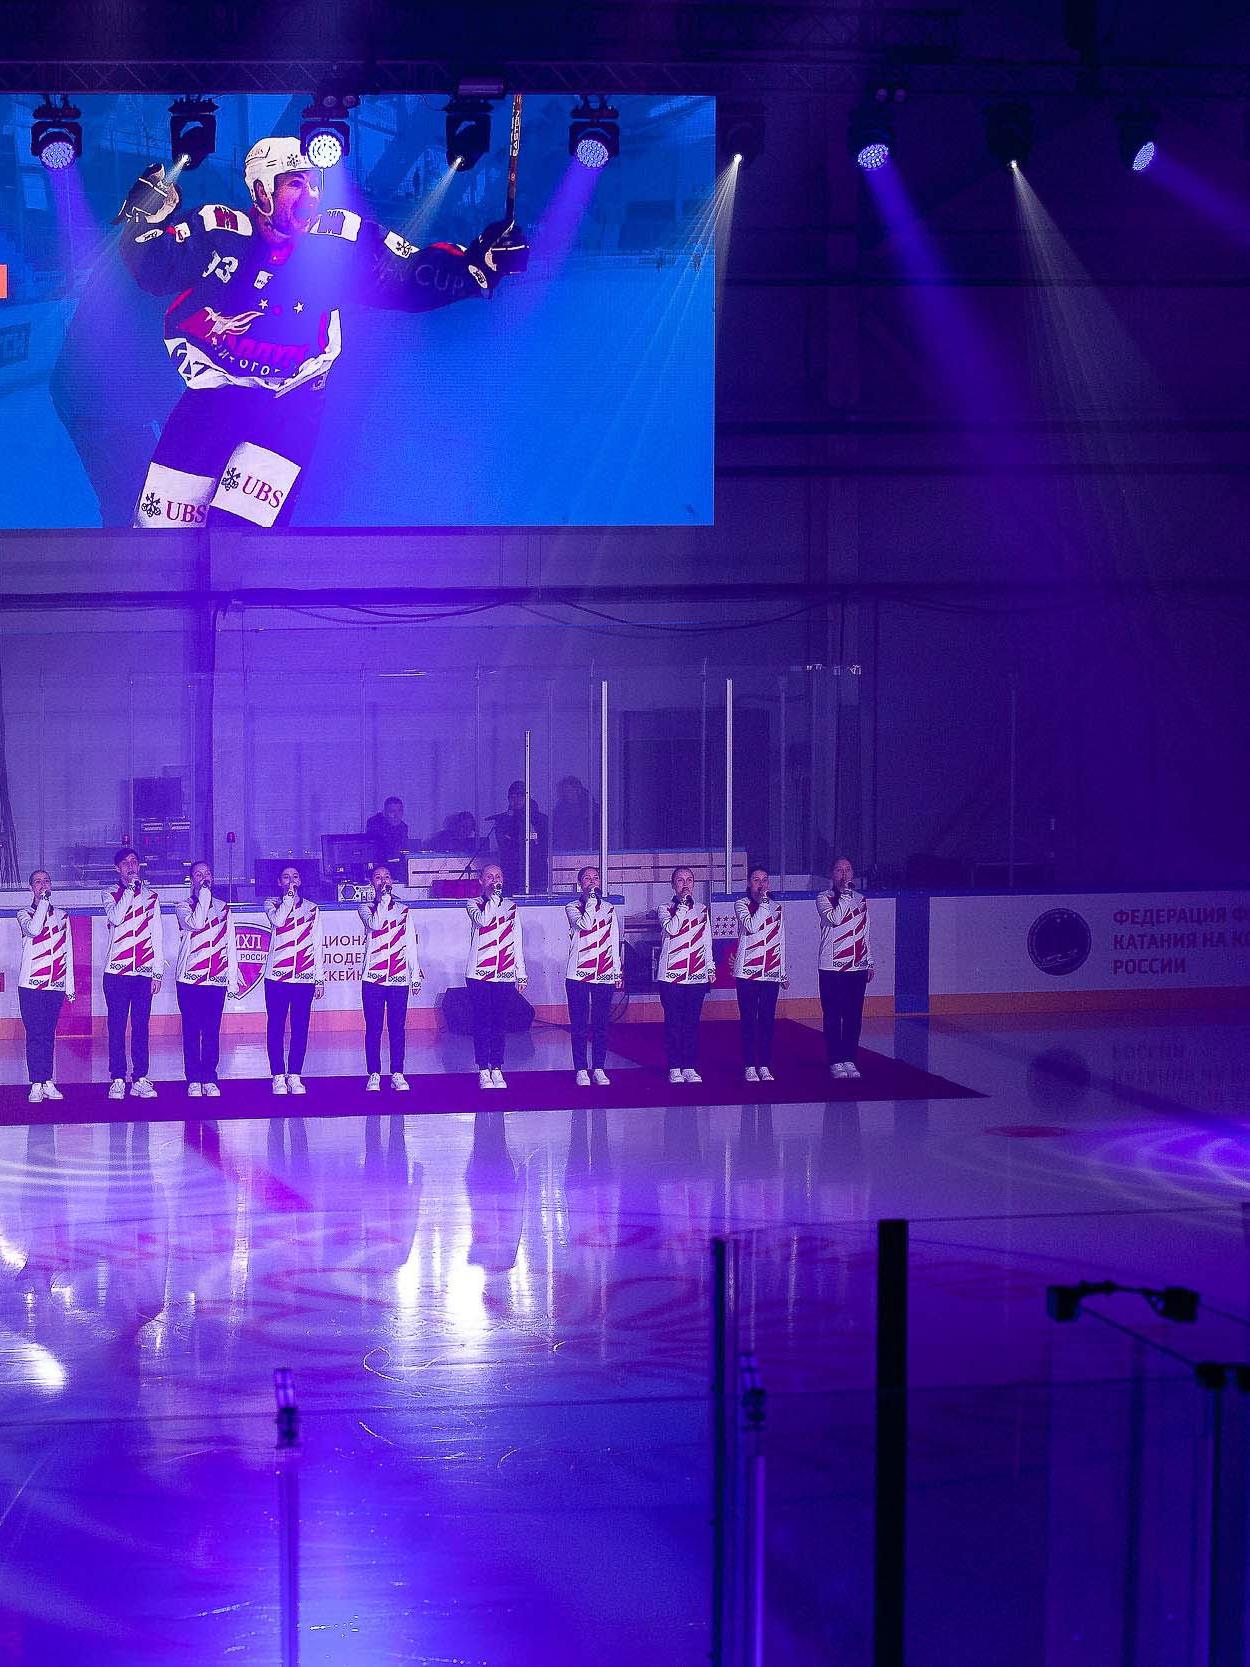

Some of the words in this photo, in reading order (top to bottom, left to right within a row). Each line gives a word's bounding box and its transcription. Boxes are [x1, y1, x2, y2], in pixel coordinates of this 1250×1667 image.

[202, 250, 239, 284] 13
[242, 475, 284, 509] UBS
[166, 500, 207, 523] UBS
[1112, 907, 1227, 926] ФЕДЕРАЦИЯ
[1231, 905, 1250, 923] Ф
[1112, 931, 1198, 950] КАТАНИЯ
[1202, 931, 1227, 948] НА
[240, 953, 269, 961] РОССИ
[1112, 957, 1187, 976] РОССИИ
